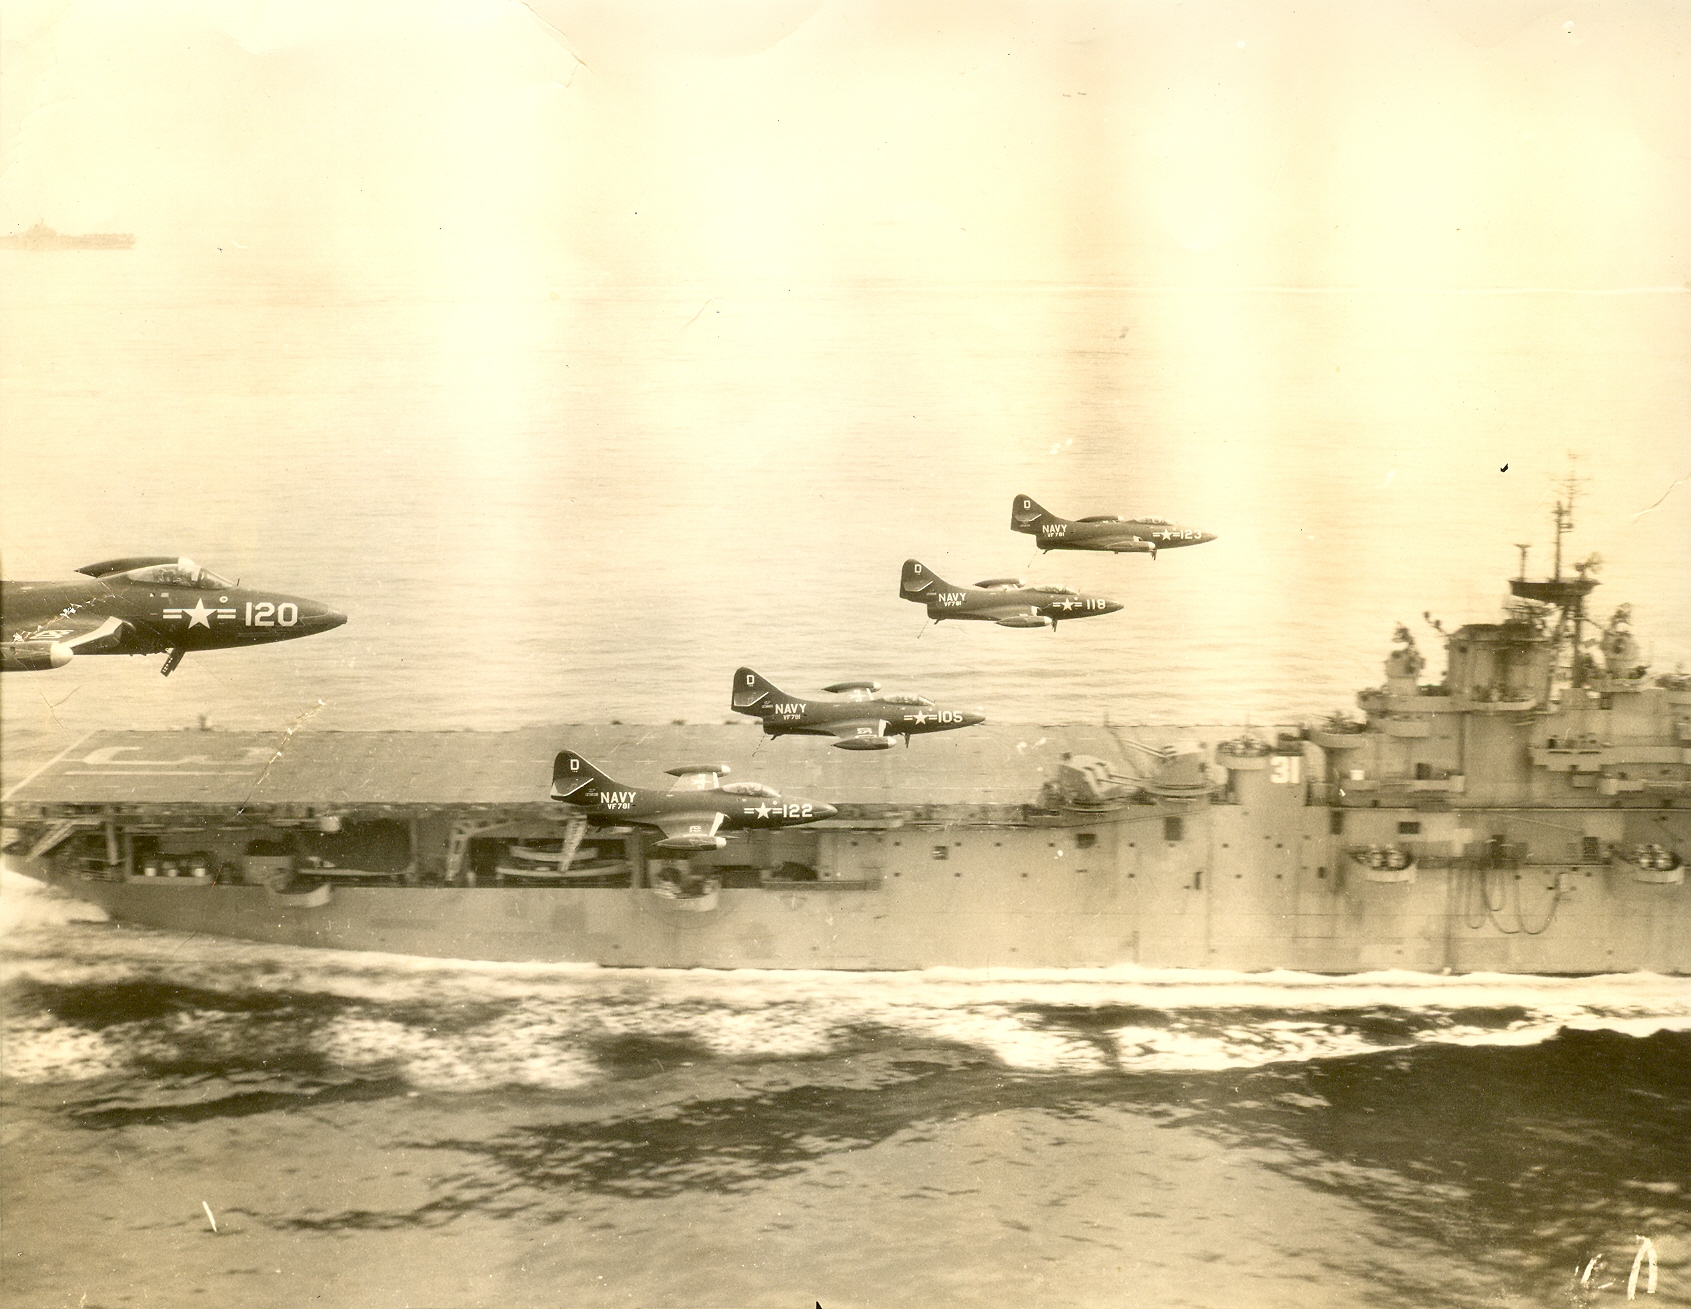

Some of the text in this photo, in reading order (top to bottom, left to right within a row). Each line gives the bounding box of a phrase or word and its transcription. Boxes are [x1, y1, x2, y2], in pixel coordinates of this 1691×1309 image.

[1023, 500, 1031, 508] D
[1042, 524, 1067, 533] NAVY
[1180, 529, 1201, 539] 123
[914, 564, 922, 573] D
[938, 592, 967, 602] NAVY
[1086, 599, 1106, 610] 118
[244, 601, 298, 627] 120
[746, 674, 755, 685] D
[775, 703, 806, 714] NAVY
[938, 710, 963, 723] 105
[570, 759, 580, 770] D
[1270, 756, 1300, 783] 31
[600, 791, 636, 804] NAVY
[783, 803, 813, 818] 122
